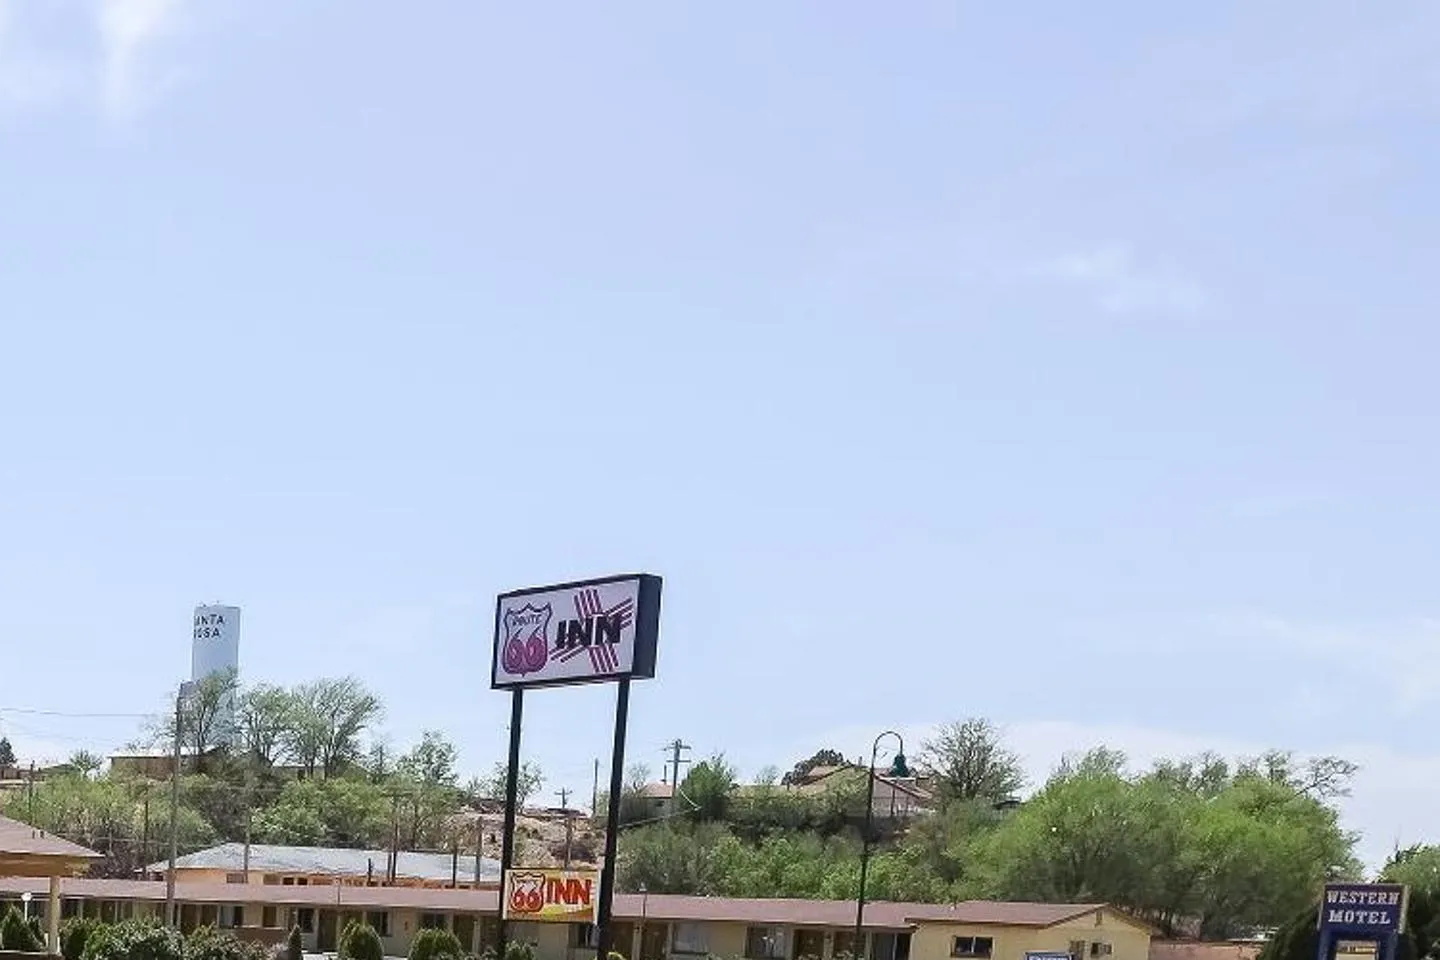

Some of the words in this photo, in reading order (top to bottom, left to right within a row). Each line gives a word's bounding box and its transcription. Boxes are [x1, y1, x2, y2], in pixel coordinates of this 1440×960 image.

[507, 624, 546, 668] 66
[555, 613, 621, 650] INN
[512, 884, 543, 911] 66
[546, 878, 593, 905] INN
[1327, 890, 1401, 905] WESTERN
[1328, 909, 1392, 925] MOTEL
